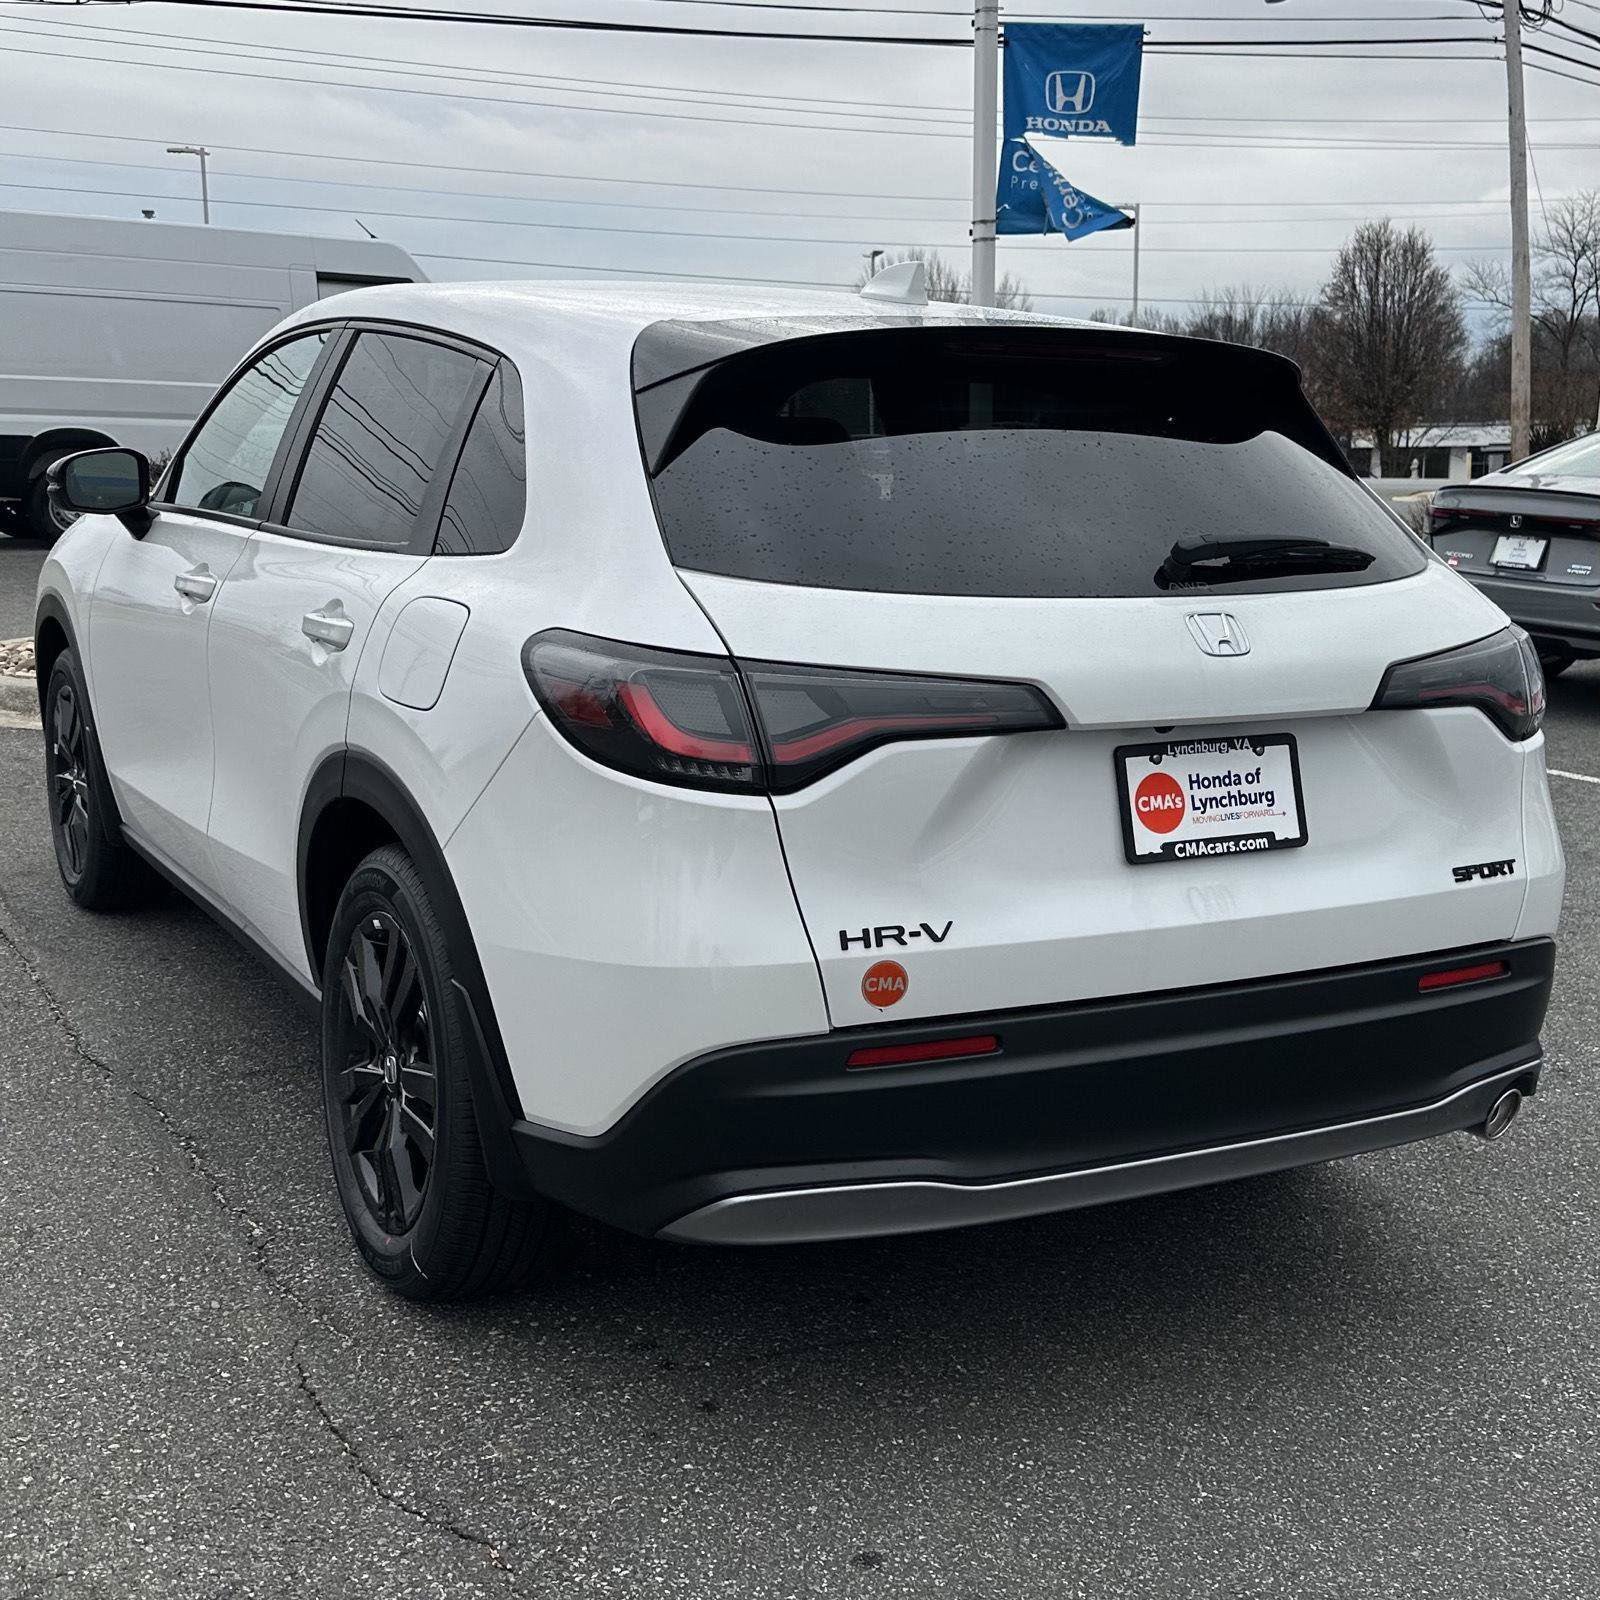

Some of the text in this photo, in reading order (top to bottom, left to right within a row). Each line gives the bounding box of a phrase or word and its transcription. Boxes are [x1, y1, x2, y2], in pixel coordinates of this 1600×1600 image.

[1025, 116, 1112, 133] HONDA
[1233, 738, 1251, 750] VA
[1188, 767, 1262, 790] Honda of
[1137, 793, 1183, 812] CMA's
[1190, 789, 1275, 814] Lynchburg
[1174, 837, 1269, 858] CMAcars.com
[1452, 858, 1516, 883] SPORT
[839, 921, 953, 951] HR-V
[864, 976, 905, 992] CMA
